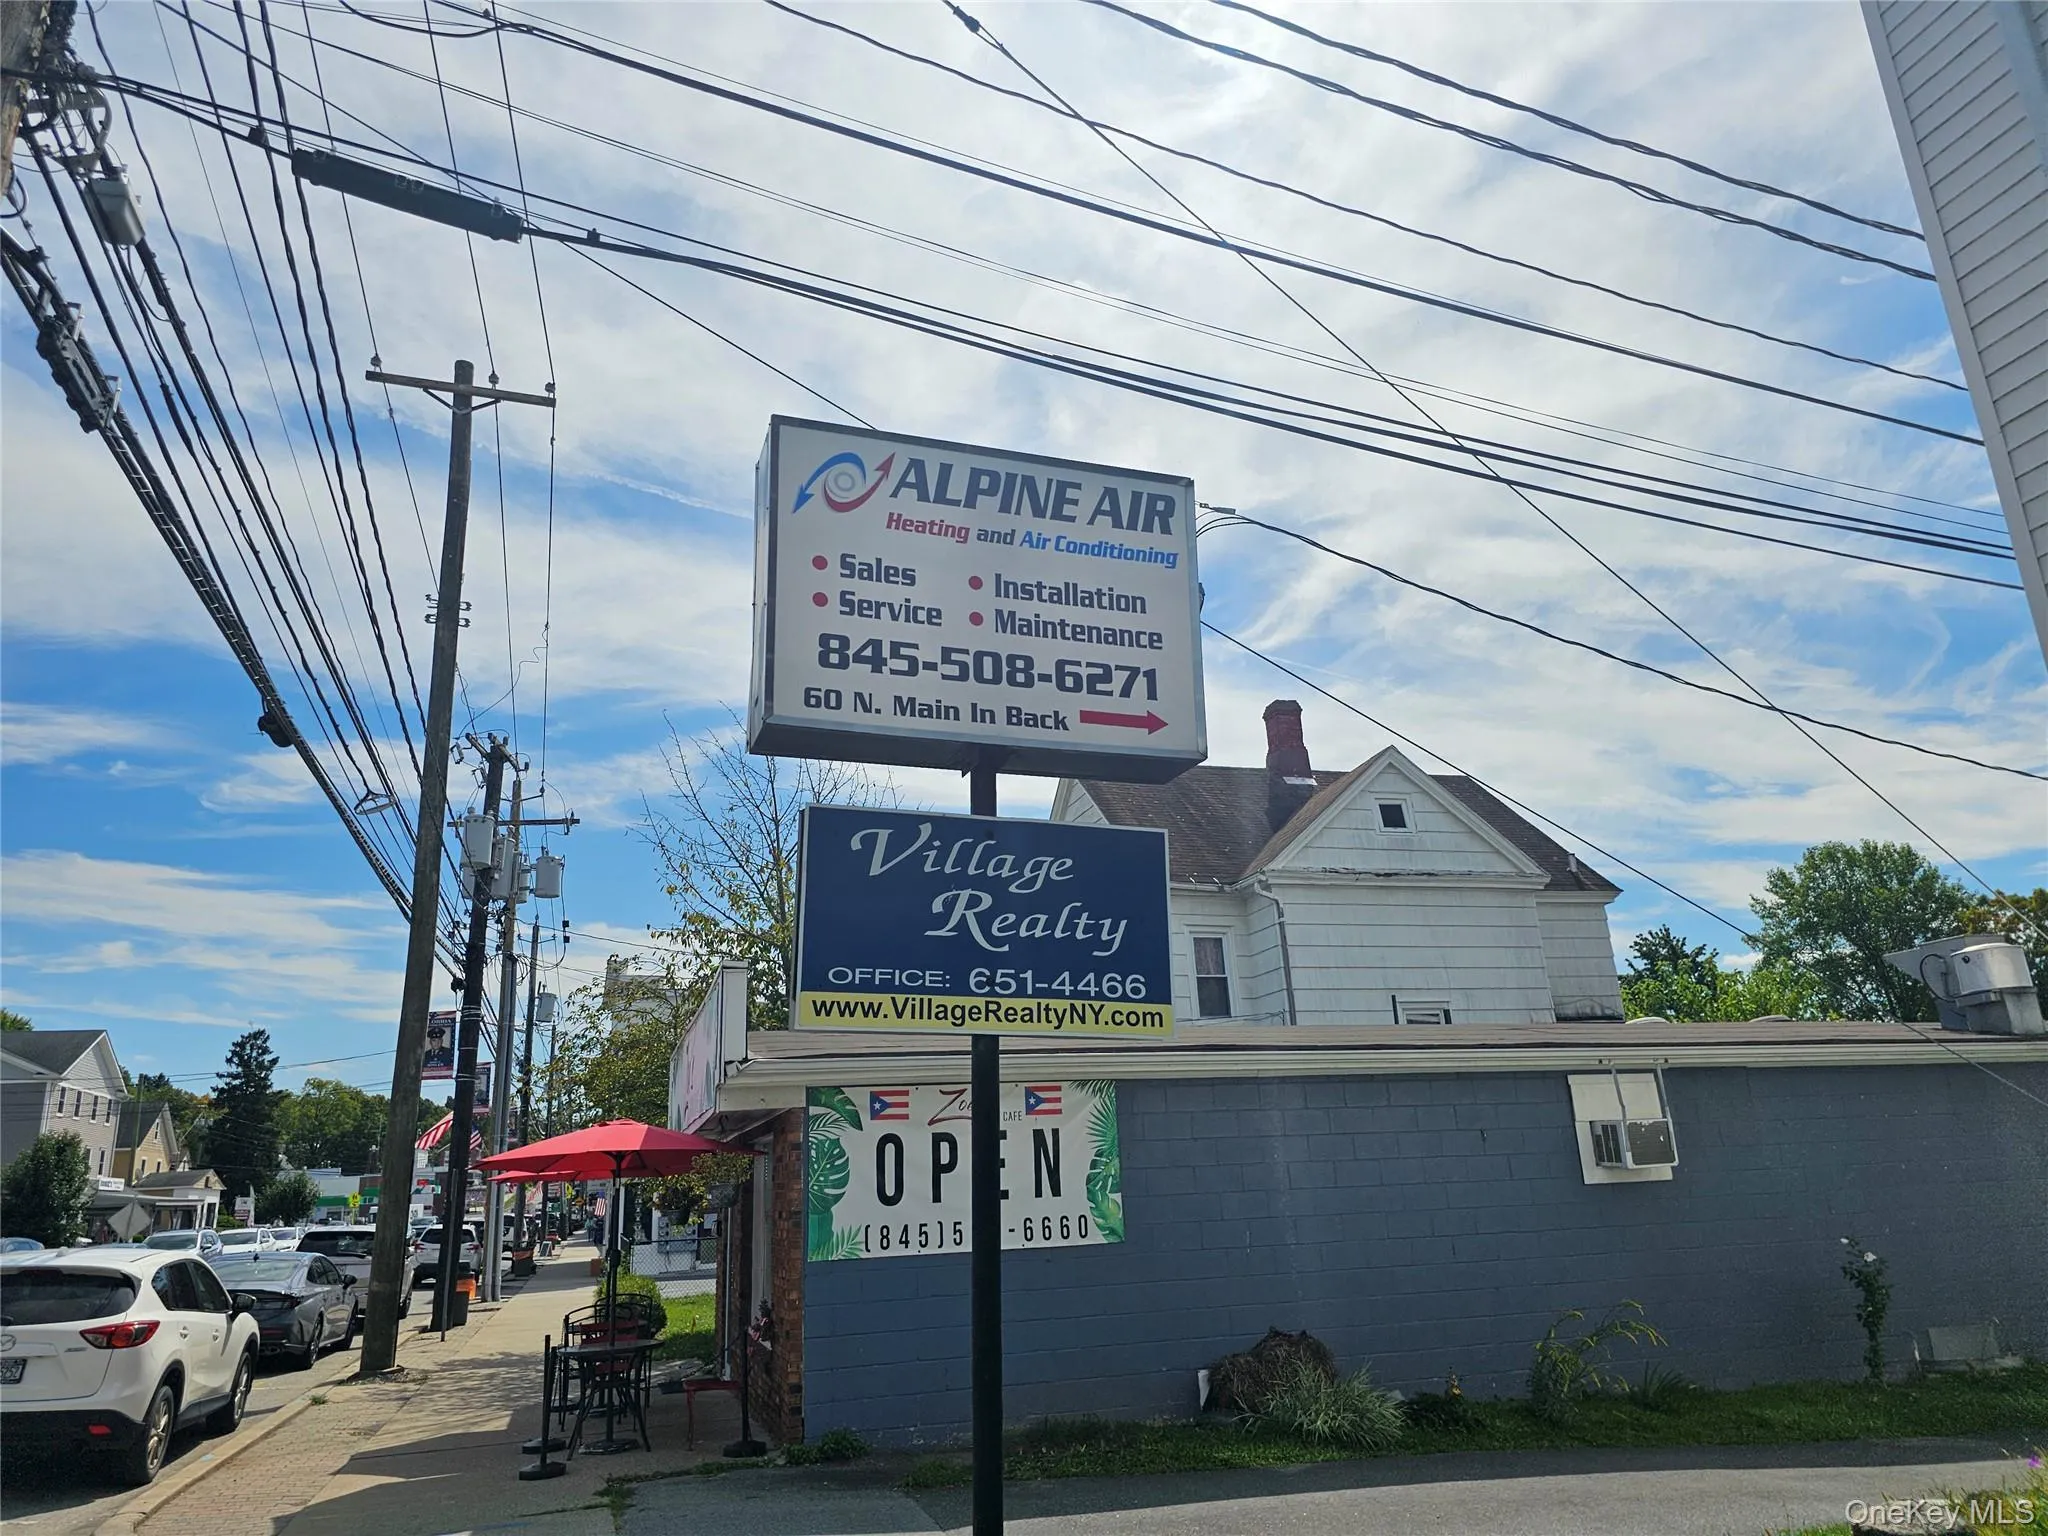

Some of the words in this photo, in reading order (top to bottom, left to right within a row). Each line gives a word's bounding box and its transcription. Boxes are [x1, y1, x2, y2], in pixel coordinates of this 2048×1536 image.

[889, 457, 1082, 524] ALPINE
[1086, 485, 1176, 536] AIR
[885, 511, 970, 544] Heating
[976, 525, 1016, 547] and
[1019, 530, 1052, 552] Air
[1054, 535, 1179, 569] Conditioning
[839, 552, 916, 587] Sales
[838, 590, 943, 627] Service
[994, 573, 1147, 615] Installation
[994, 609, 1163, 651] Maintenance
[817, 632, 1159, 701] 845-508-6271
[803, 686, 843, 711] 60
[853, 691, 882, 715] N.
[893, 694, 961, 723] Main
[971, 701, 997, 725] In
[1005, 704, 1070, 732] Back
[850, 822, 1074, 894] Village
[924, 887, 1128, 957] Realty
[828, 966, 951, 988] OFFICE:
[968, 967, 1147, 999] 651-4466
[812, 996, 1164, 1030] www.VillageRealtyNY.com
[864, 1214, 1089, 1253] (845)5-6660
